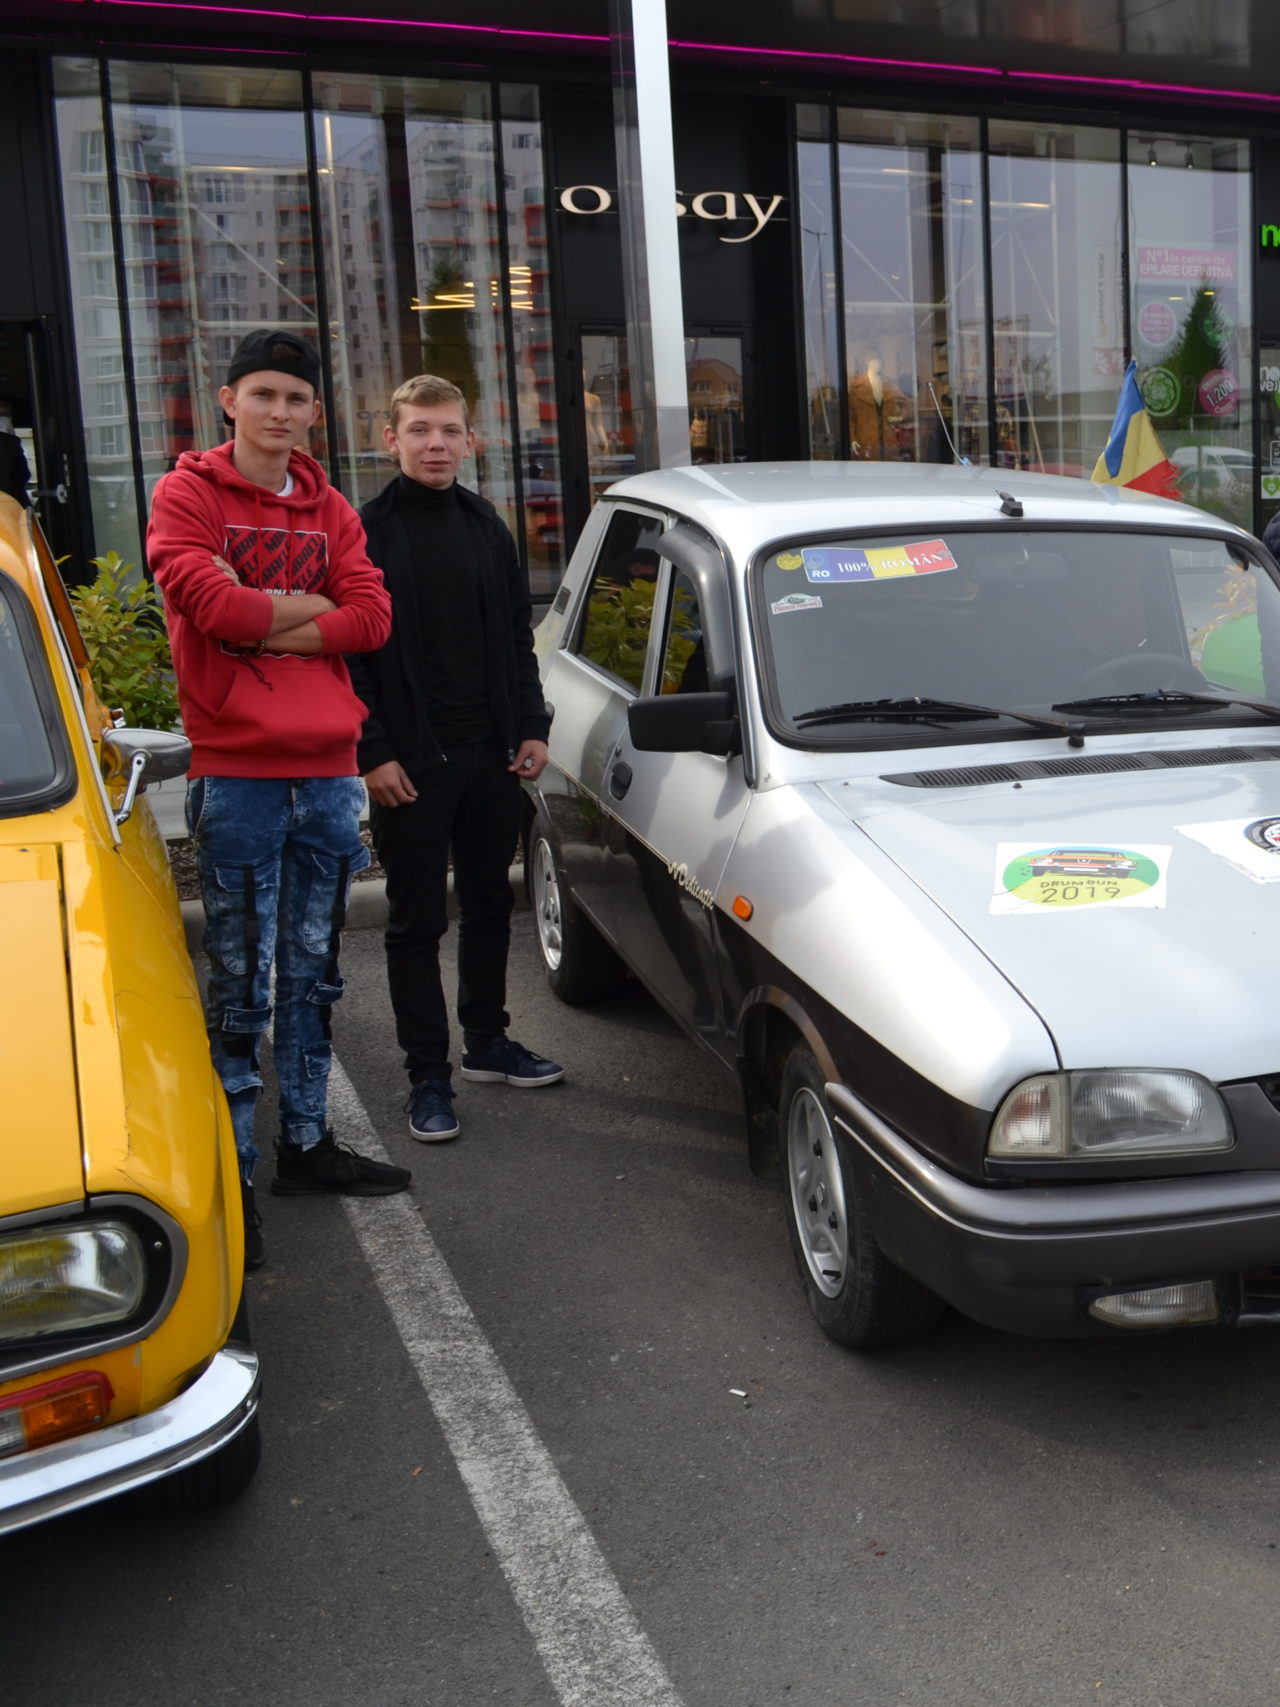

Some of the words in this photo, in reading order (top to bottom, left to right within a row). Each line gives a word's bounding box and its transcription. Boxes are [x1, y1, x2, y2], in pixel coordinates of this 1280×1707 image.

[560, 184, 783, 243] osay
[1139, 263, 1180, 276] EPILARE
[1206, 378, 1234, 407] 1.200
[811, 569, 830, 578] RO
[836, 560, 878, 574] 100%
[880, 552, 944, 571] ROMÂN
[1040, 880, 1084, 888] DRUM
[1086, 879, 1118, 887] BUN
[1041, 886, 1121, 903] 2019
